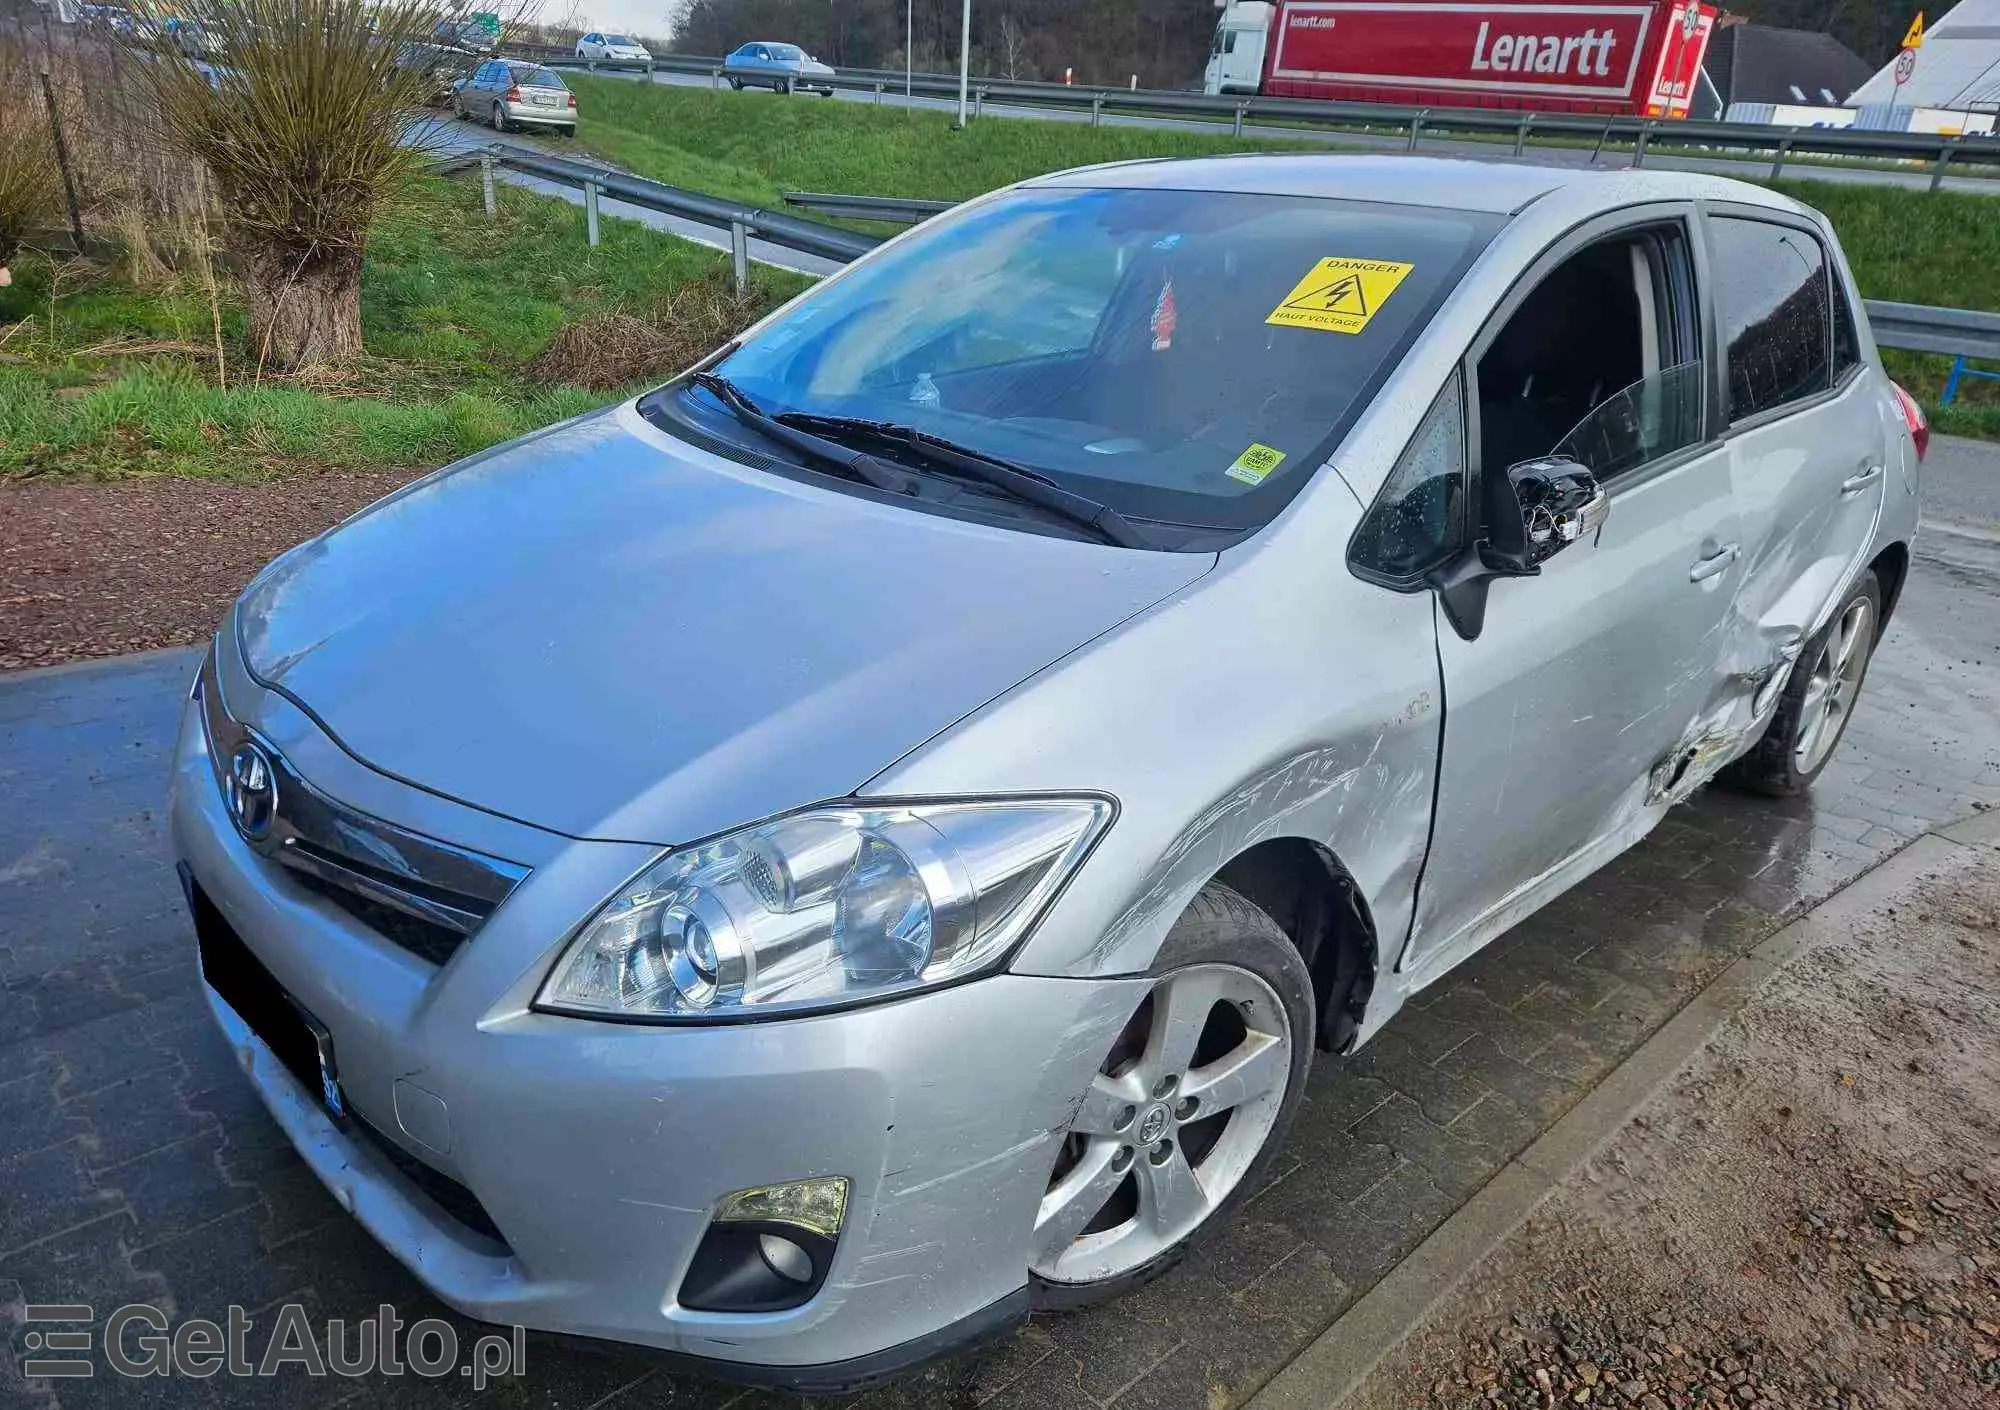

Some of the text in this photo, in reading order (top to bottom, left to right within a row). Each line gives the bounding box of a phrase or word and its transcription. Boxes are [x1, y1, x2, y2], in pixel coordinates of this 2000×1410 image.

[1290, 14, 1336, 28] lenartt.com
[1684, 9, 1698, 30] 50
[1471, 21, 1616, 76] Lenartt
[1899, 56, 1913, 76] 50
[1327, 260, 1400, 273] DANGER
[1275, 311, 1361, 327] HAUT VOLTAGE
